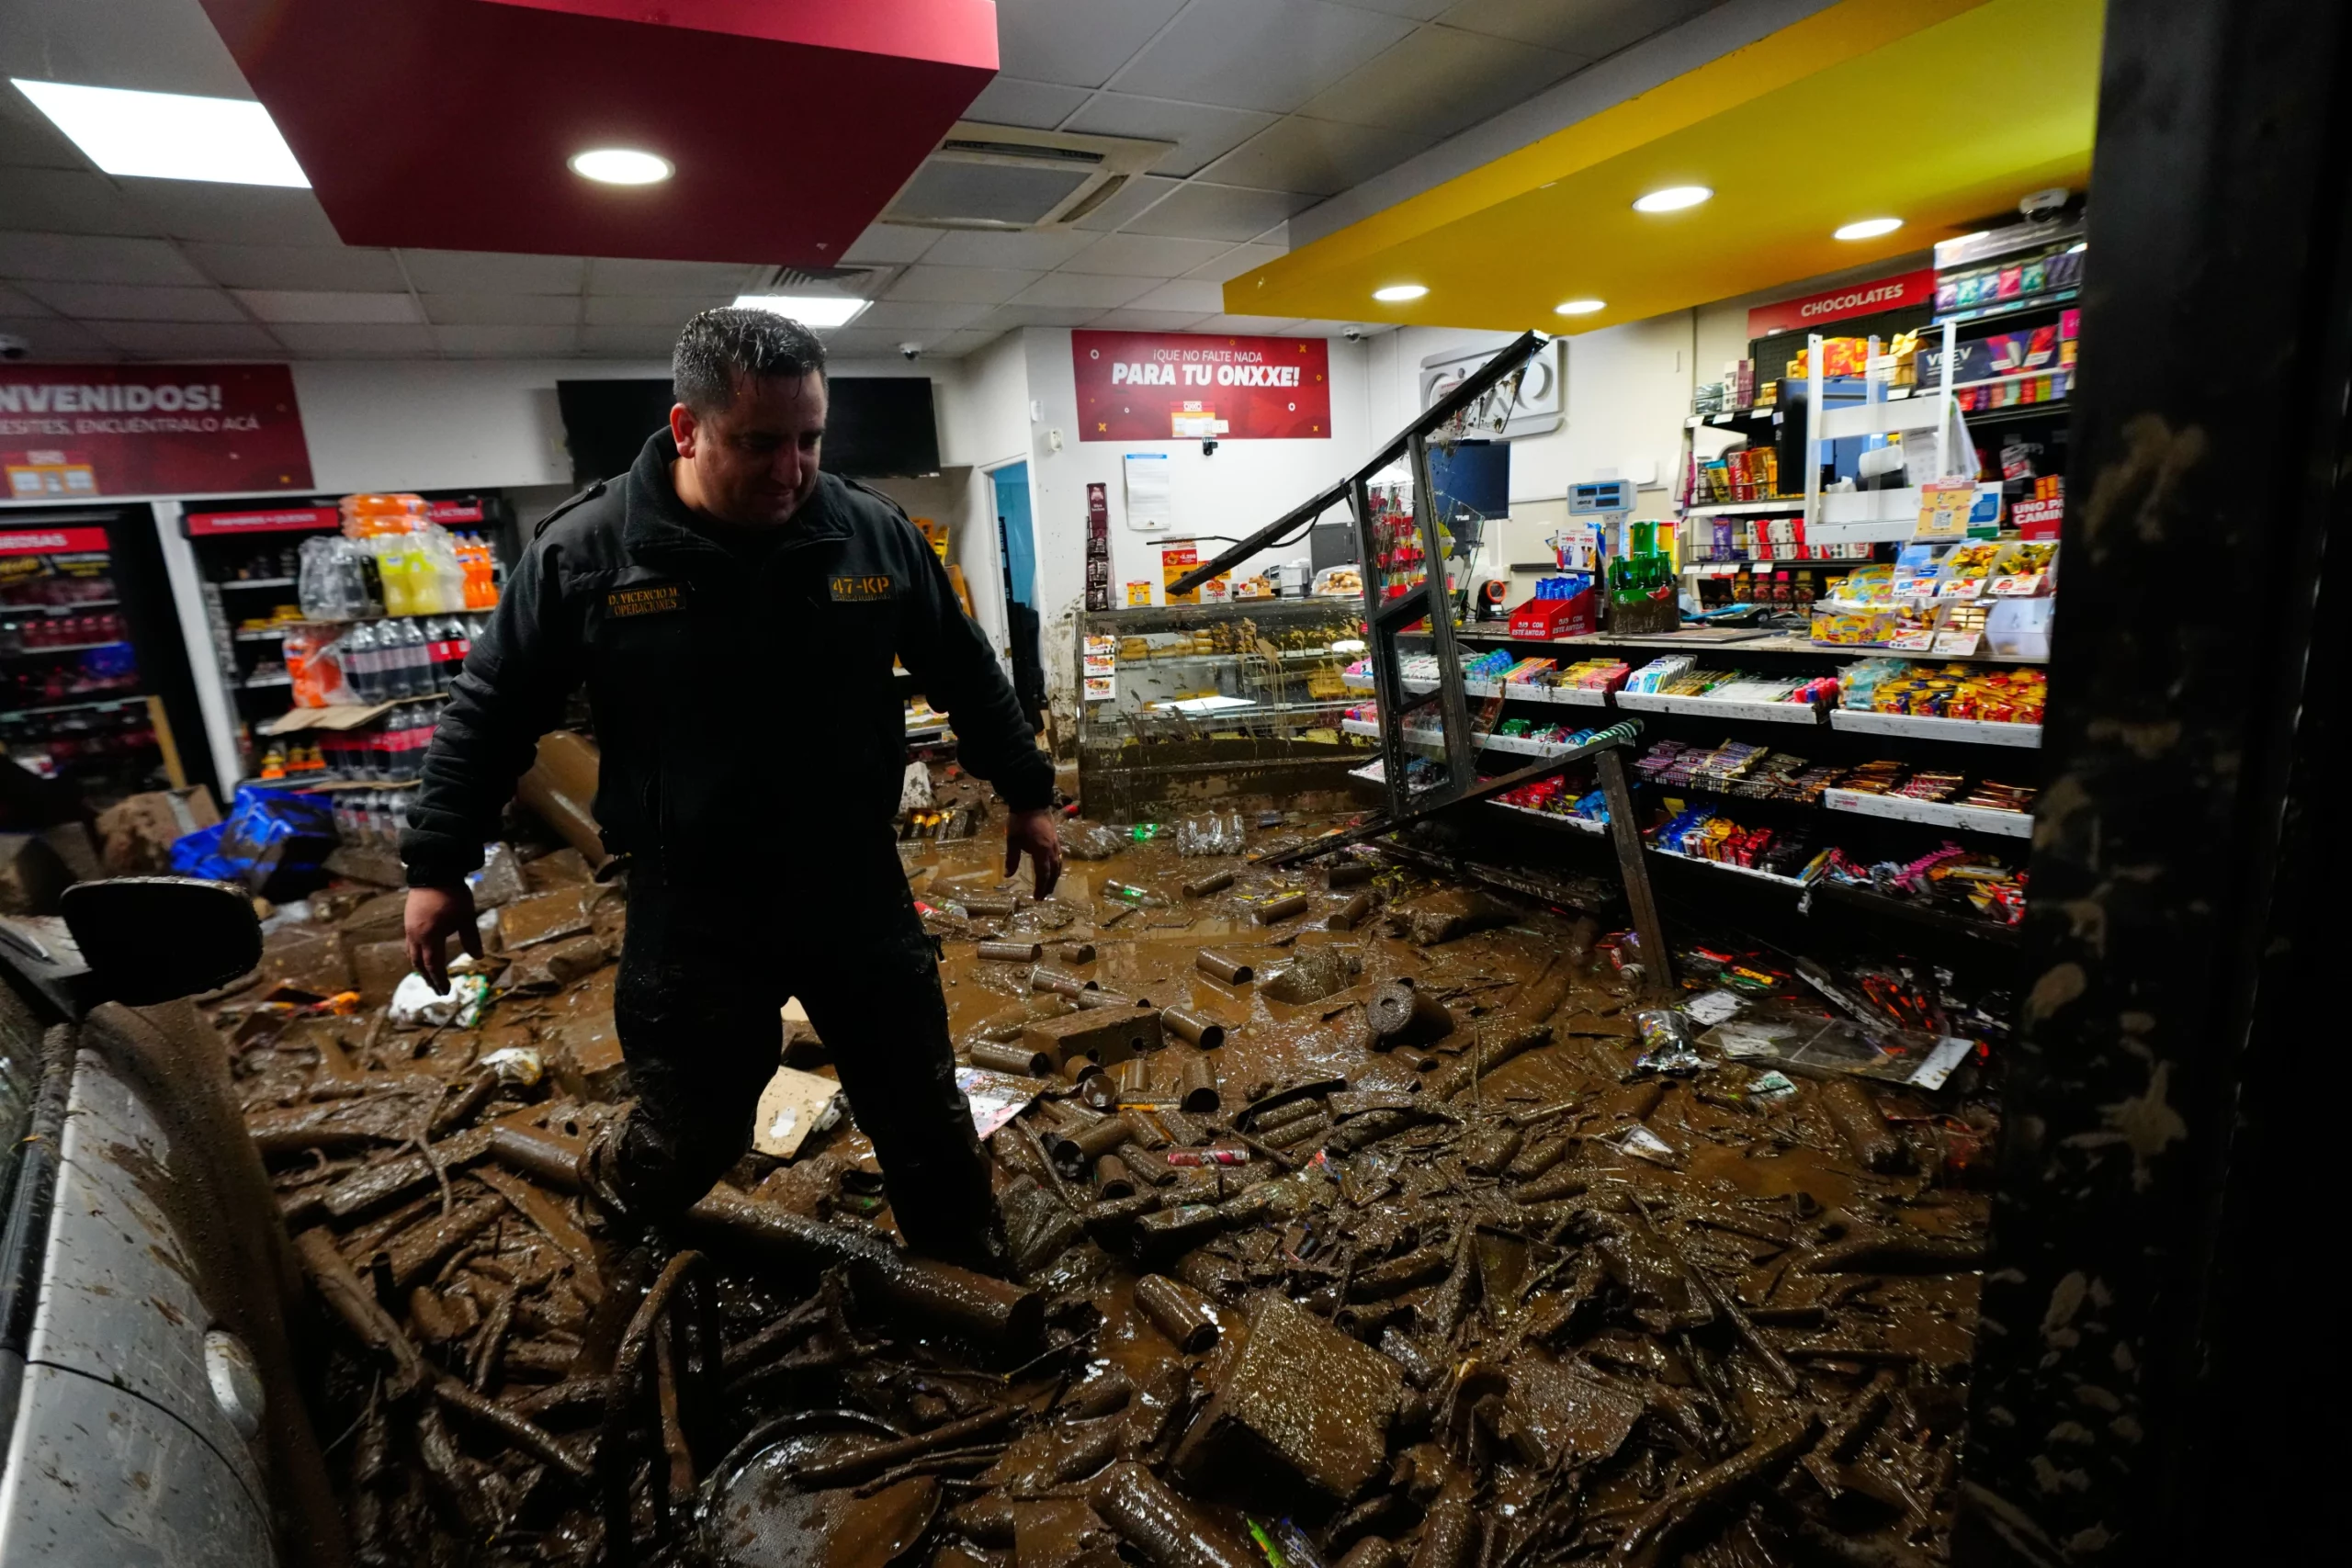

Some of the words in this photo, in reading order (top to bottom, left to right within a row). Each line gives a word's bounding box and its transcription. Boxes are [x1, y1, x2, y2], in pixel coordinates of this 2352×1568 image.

[1801, 283, 1904, 318] CHOCOLATES
[1153, 349, 1181, 362] ¡QUE
[1182, 350, 1200, 362] NO
[1202, 351, 1232, 362] FALTE
[1234, 352, 1262, 363] NADA
[1112, 363, 1176, 385] PARA
[1182, 365, 1213, 386] TU
[1217, 366, 1300, 387] ONXXE!
[221, 412, 260, 432] ACÁ
[2013, 502, 2046, 514] UNO
[832, 577, 889, 594] 47-KP
[613, 599, 676, 616] OPERACIONES
